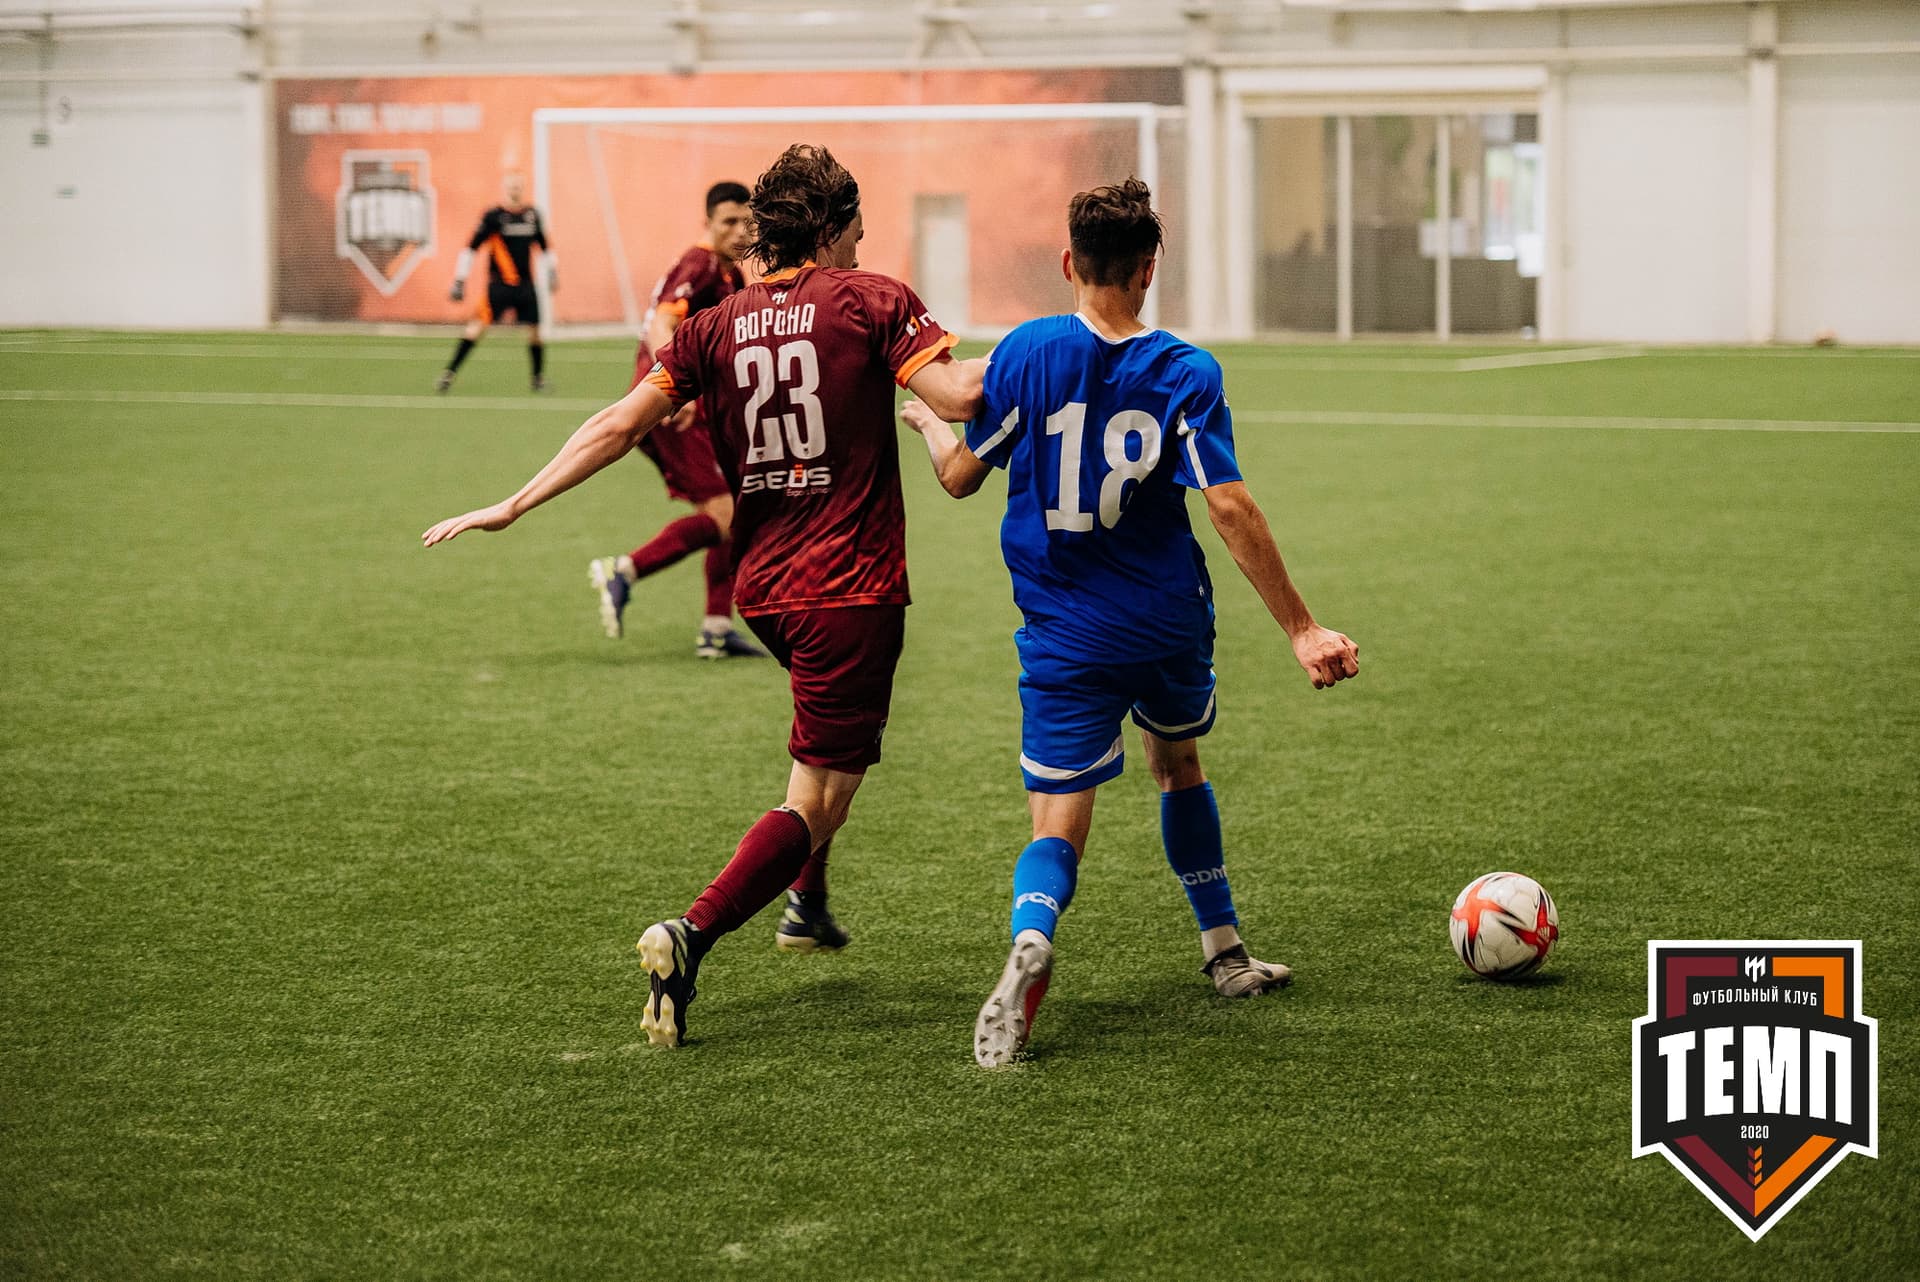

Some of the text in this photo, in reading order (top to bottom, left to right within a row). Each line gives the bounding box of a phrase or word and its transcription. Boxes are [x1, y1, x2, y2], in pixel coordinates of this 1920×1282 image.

[734, 303, 816, 345] ВОРОНА
[734, 340, 827, 465] 23
[741, 466, 832, 494] SEUS
[1046, 401, 1162, 532] 18
[1178, 865, 1228, 886] CDM
